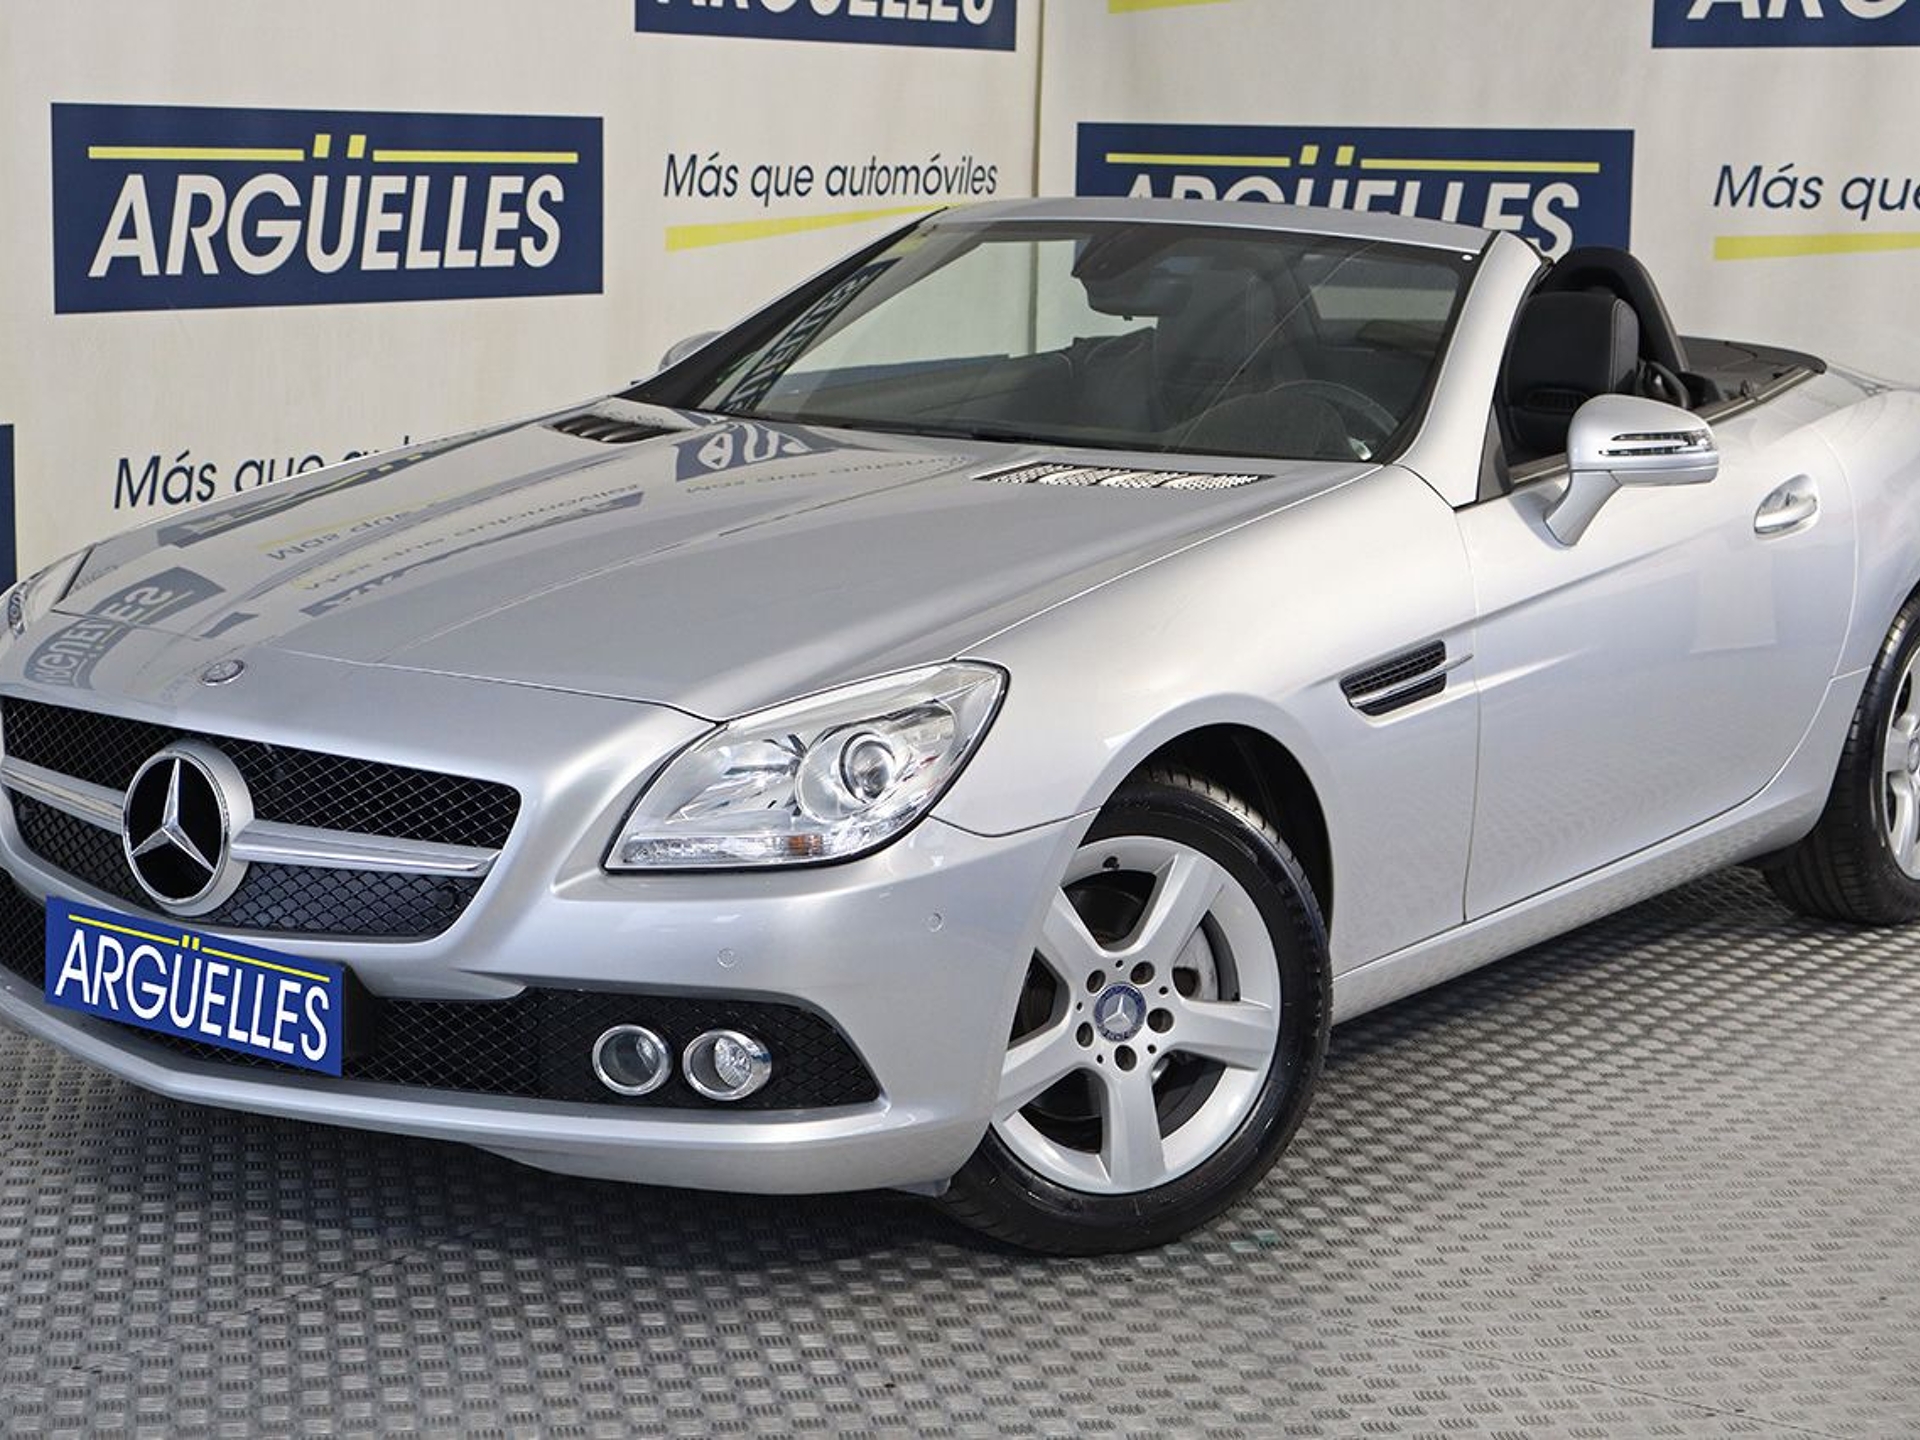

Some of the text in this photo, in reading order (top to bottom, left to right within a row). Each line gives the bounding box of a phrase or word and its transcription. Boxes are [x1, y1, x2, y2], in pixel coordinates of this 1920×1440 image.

[87, 133, 565, 278] ARGÜELLES
[663, 151, 998, 208] Más que automóviles
[1712, 162, 1920, 222] Más qu
[113, 449, 218, 510] Más
[54, 928, 331, 1063] ARGÜELLES
